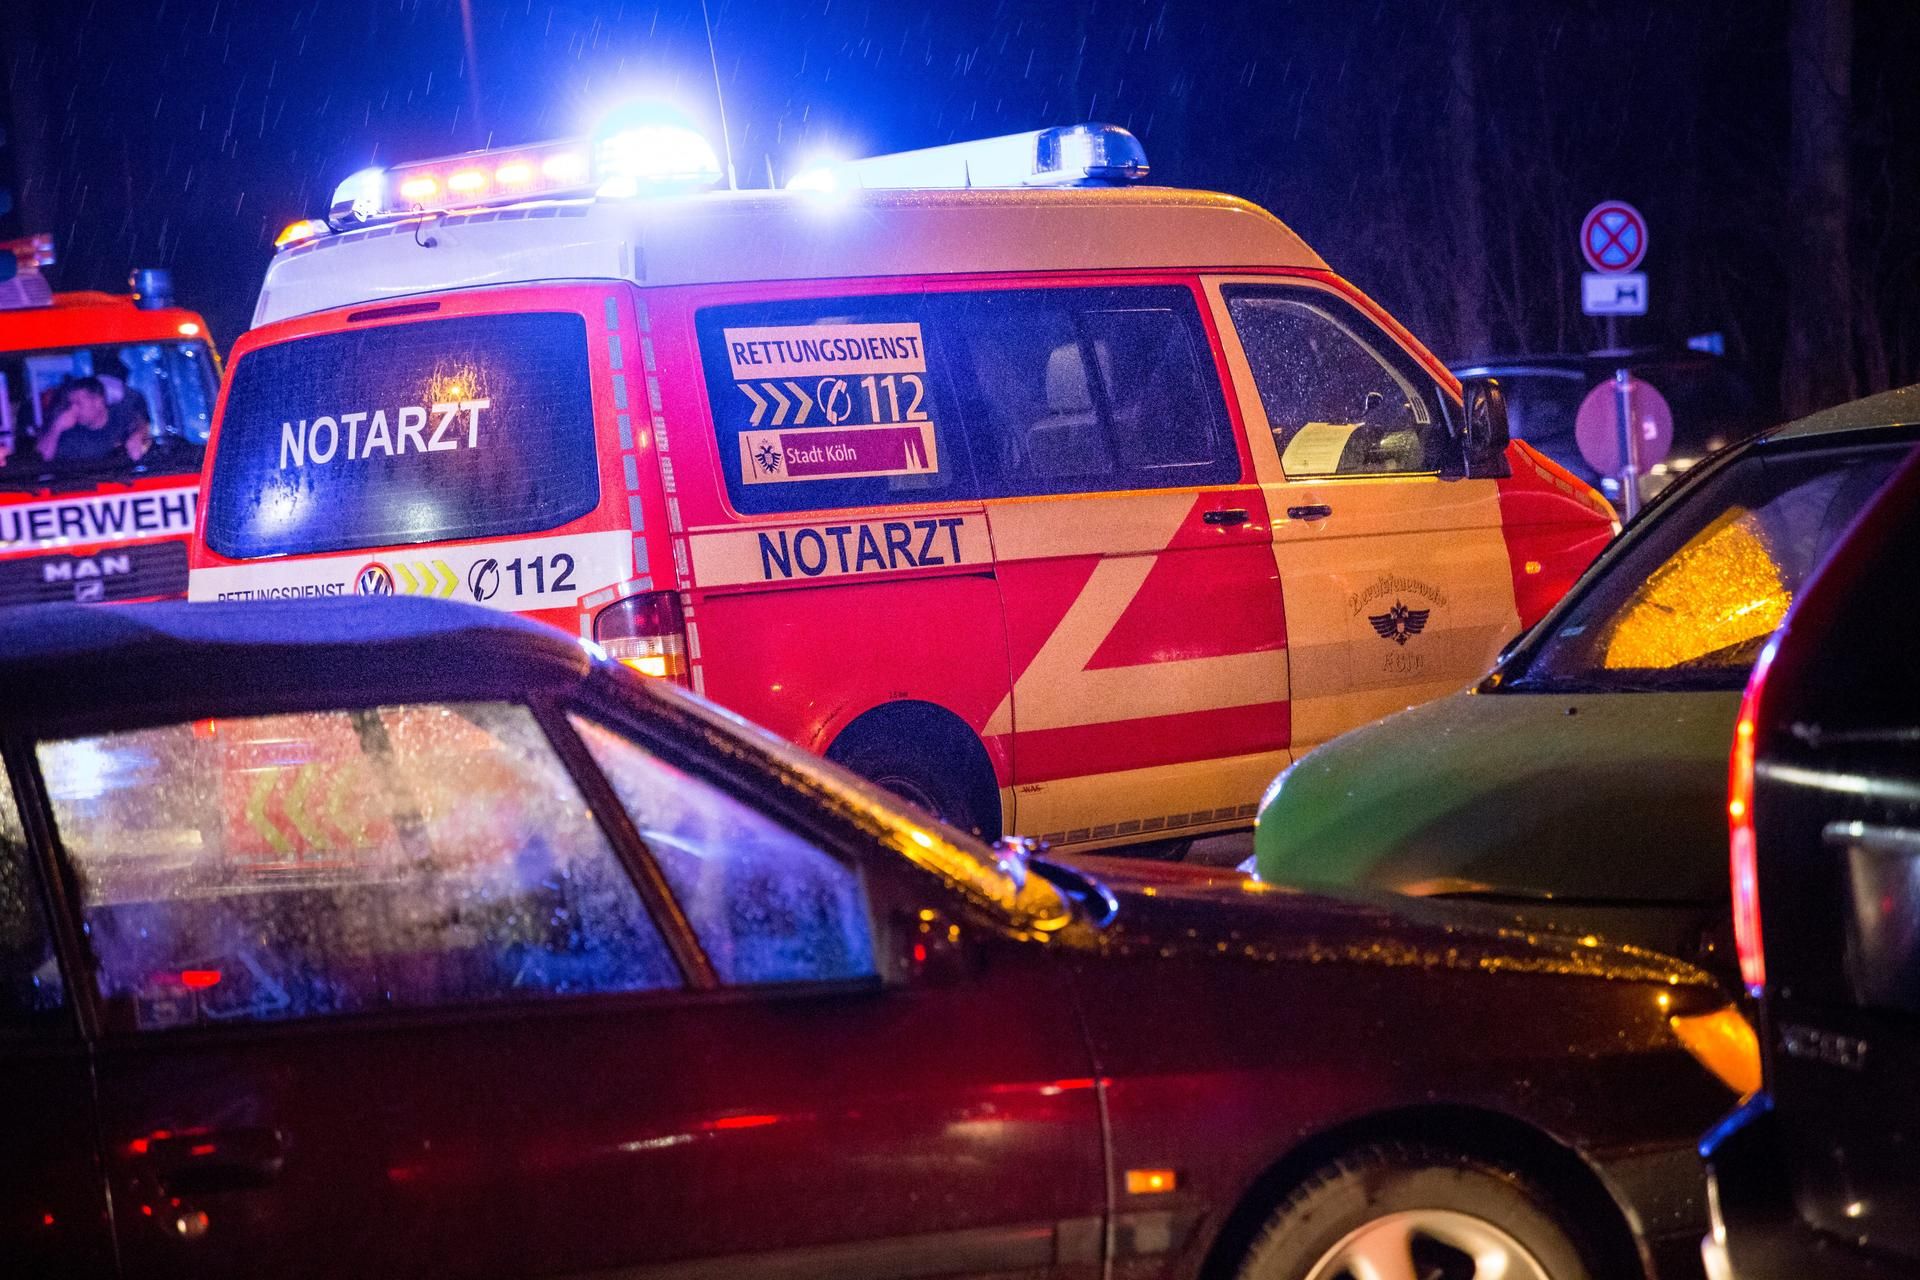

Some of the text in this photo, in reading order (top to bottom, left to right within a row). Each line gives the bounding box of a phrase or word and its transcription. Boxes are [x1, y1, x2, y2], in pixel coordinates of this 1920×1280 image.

[732, 336, 918, 365] RETTUNGSDIENST
[861, 374, 928, 423] 112
[280, 399, 491, 469] NOTARZT
[786, 443, 857, 464] Stadt Köln
[0, 493, 199, 541] UERWEH
[43, 555, 130, 582] MAN
[758, 518, 964, 580] NOTARZT
[506, 553, 576, 595] 112
